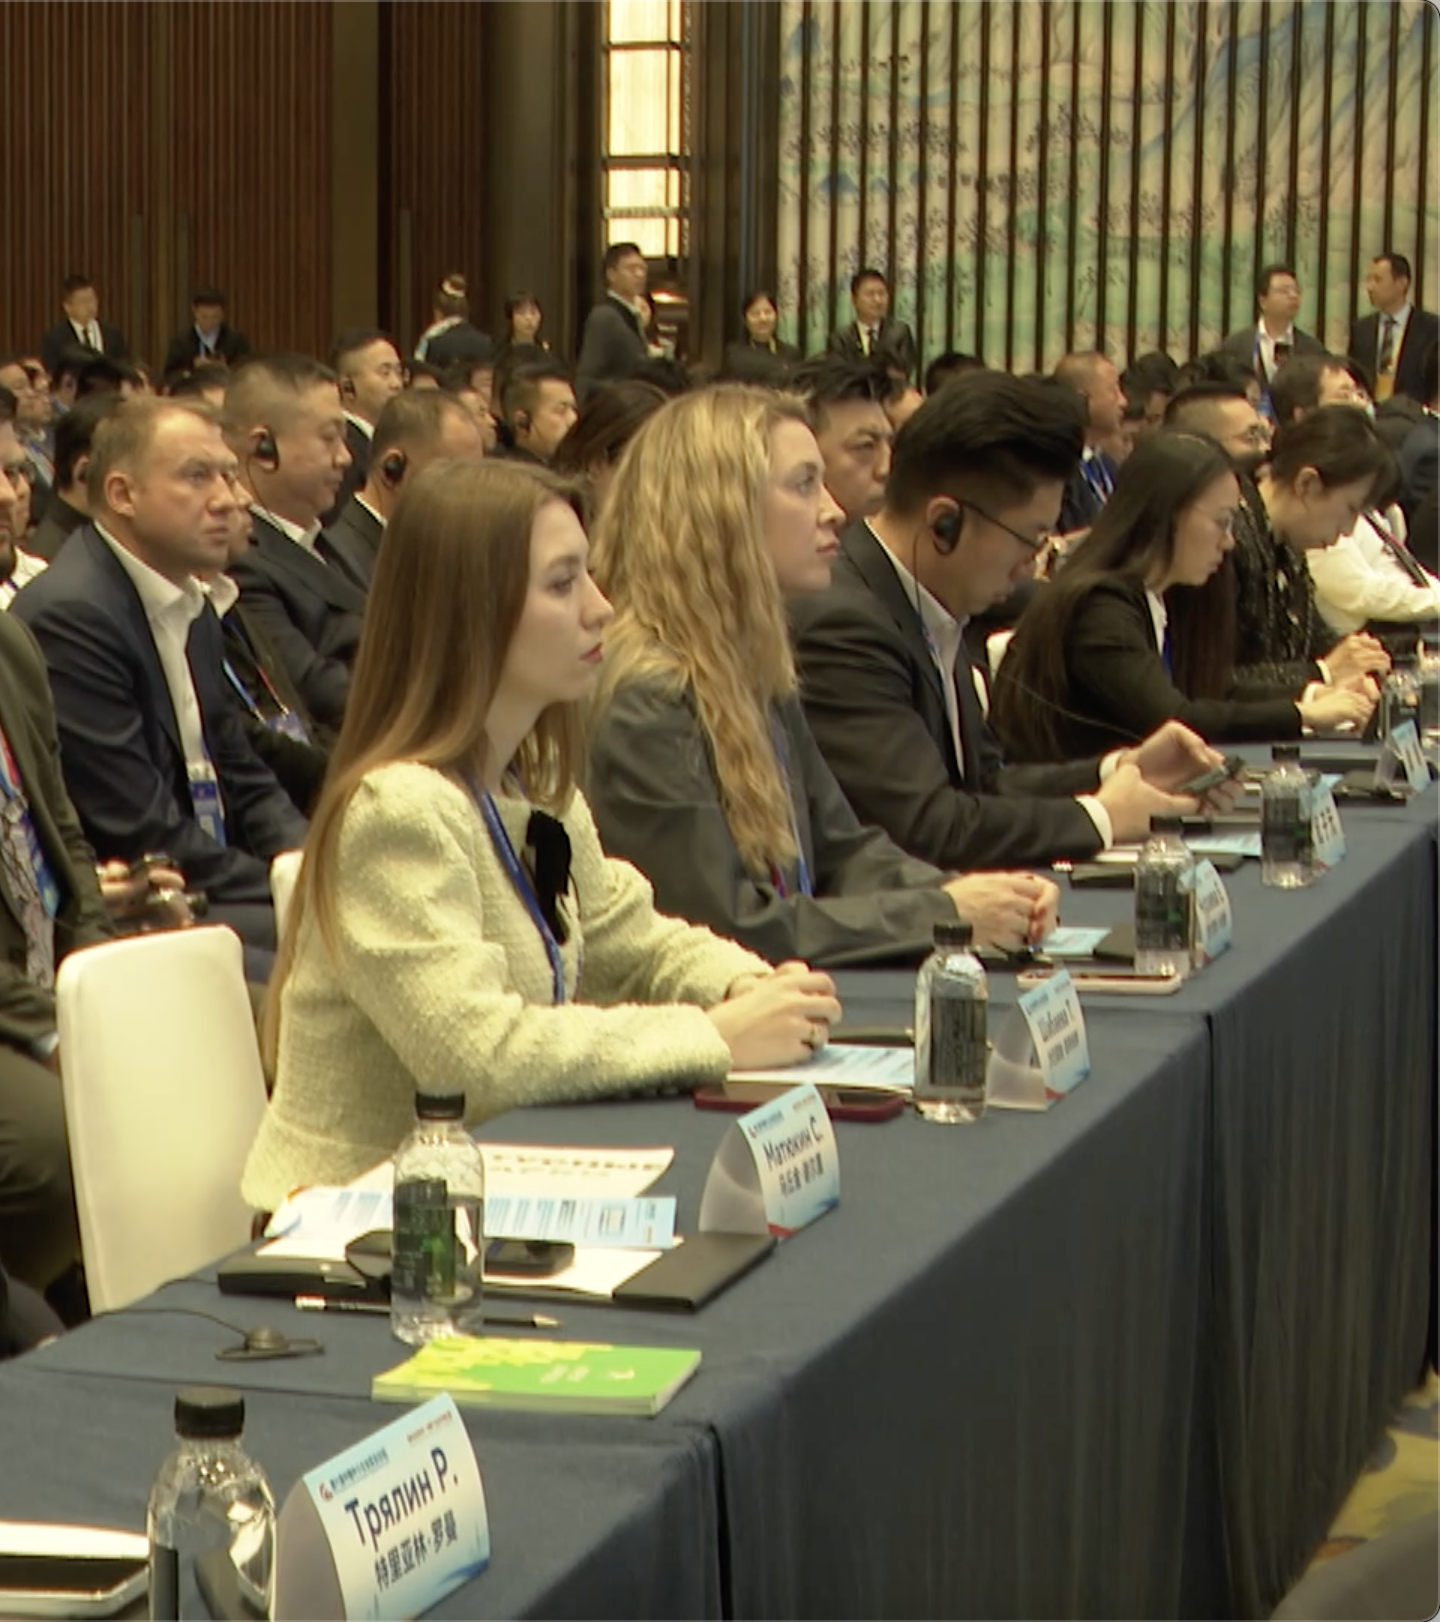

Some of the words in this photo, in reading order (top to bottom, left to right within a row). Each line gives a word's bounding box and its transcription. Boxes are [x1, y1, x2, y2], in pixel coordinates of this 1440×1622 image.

[762, 1133, 812, 1172] Матюкин
[809, 1115, 824, 1143] С.
[343, 1466, 433, 1551] Трялин
[429, 1446, 460, 1493] Р.
[373, 1508, 458, 1592] 特里亚林·罗曼
